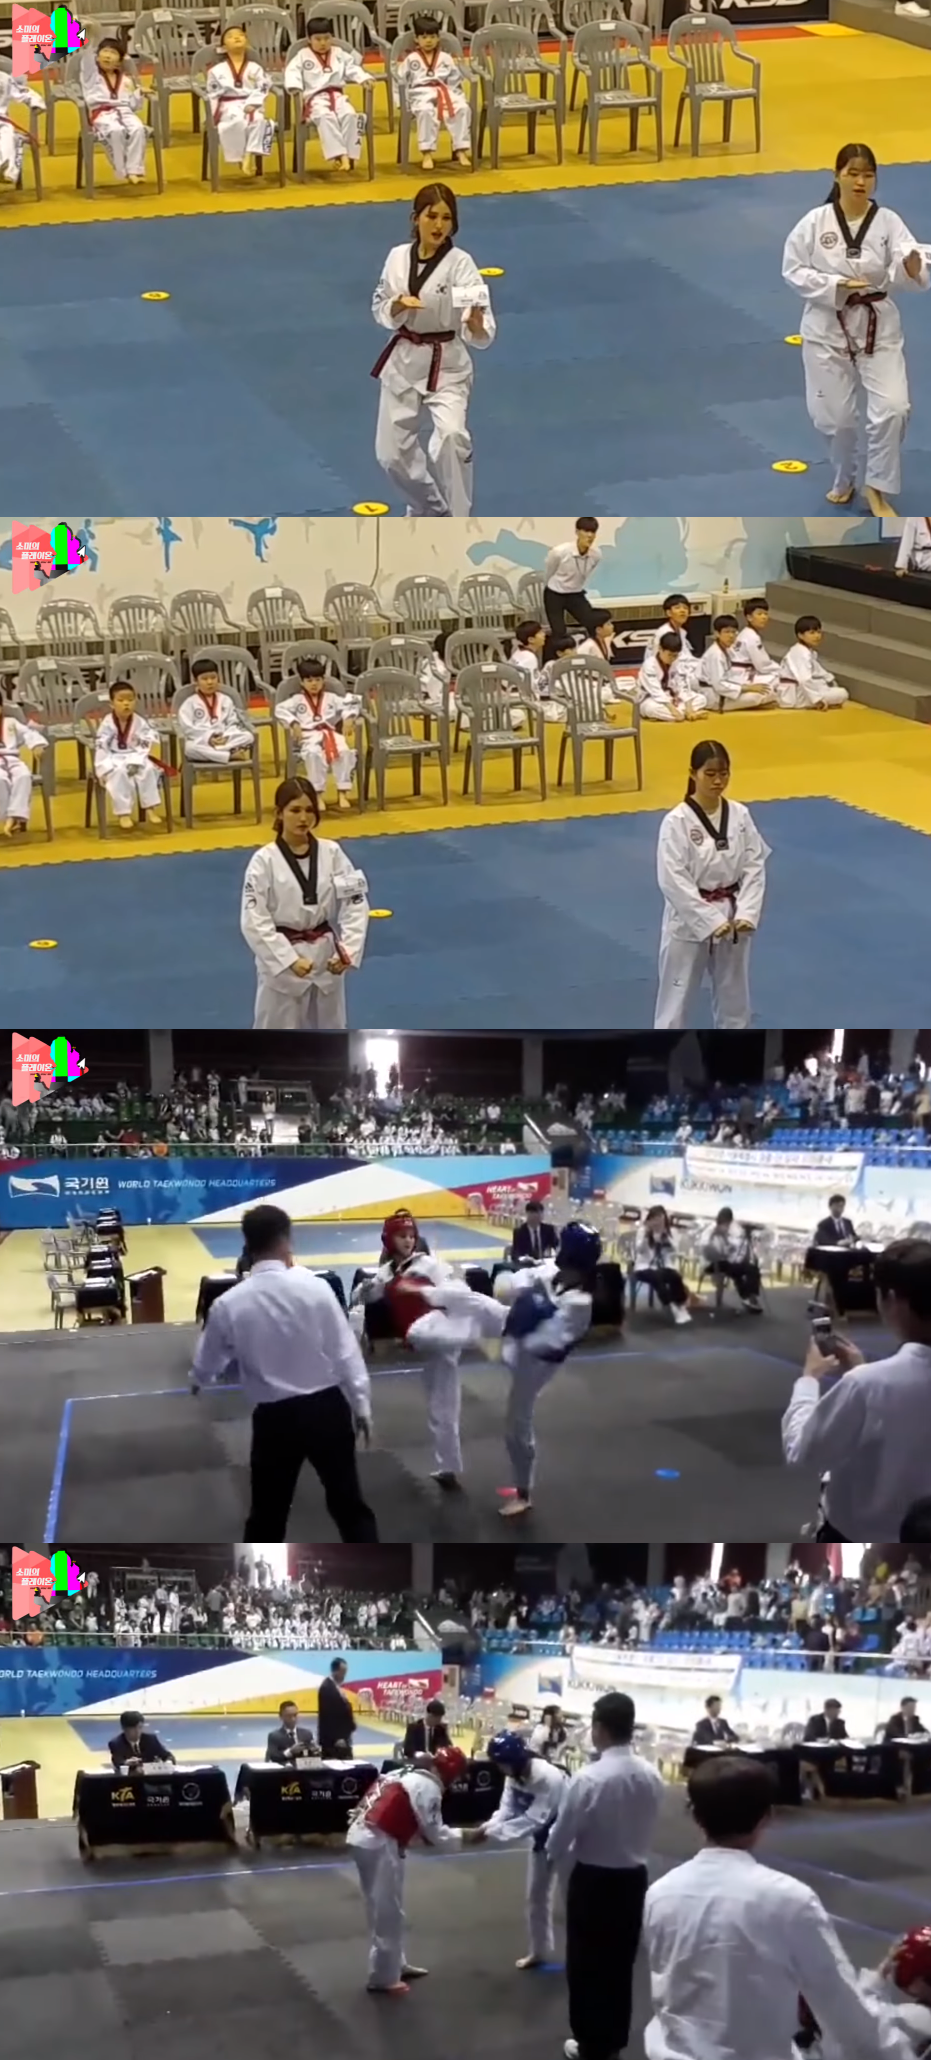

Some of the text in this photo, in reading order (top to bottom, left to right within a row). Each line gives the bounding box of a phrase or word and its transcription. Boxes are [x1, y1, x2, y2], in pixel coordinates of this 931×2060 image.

[64, 1177, 109, 1189] 국기원
[118, 1178, 276, 1189] WORLD TAEKWONDO HEADQUARTERS
[0, 1670, 157, 1678] ORLD TAEKWONDO HEADQUARTERS
[111, 1786, 135, 1802] KTA
[281, 1782, 301, 1796] KTA
